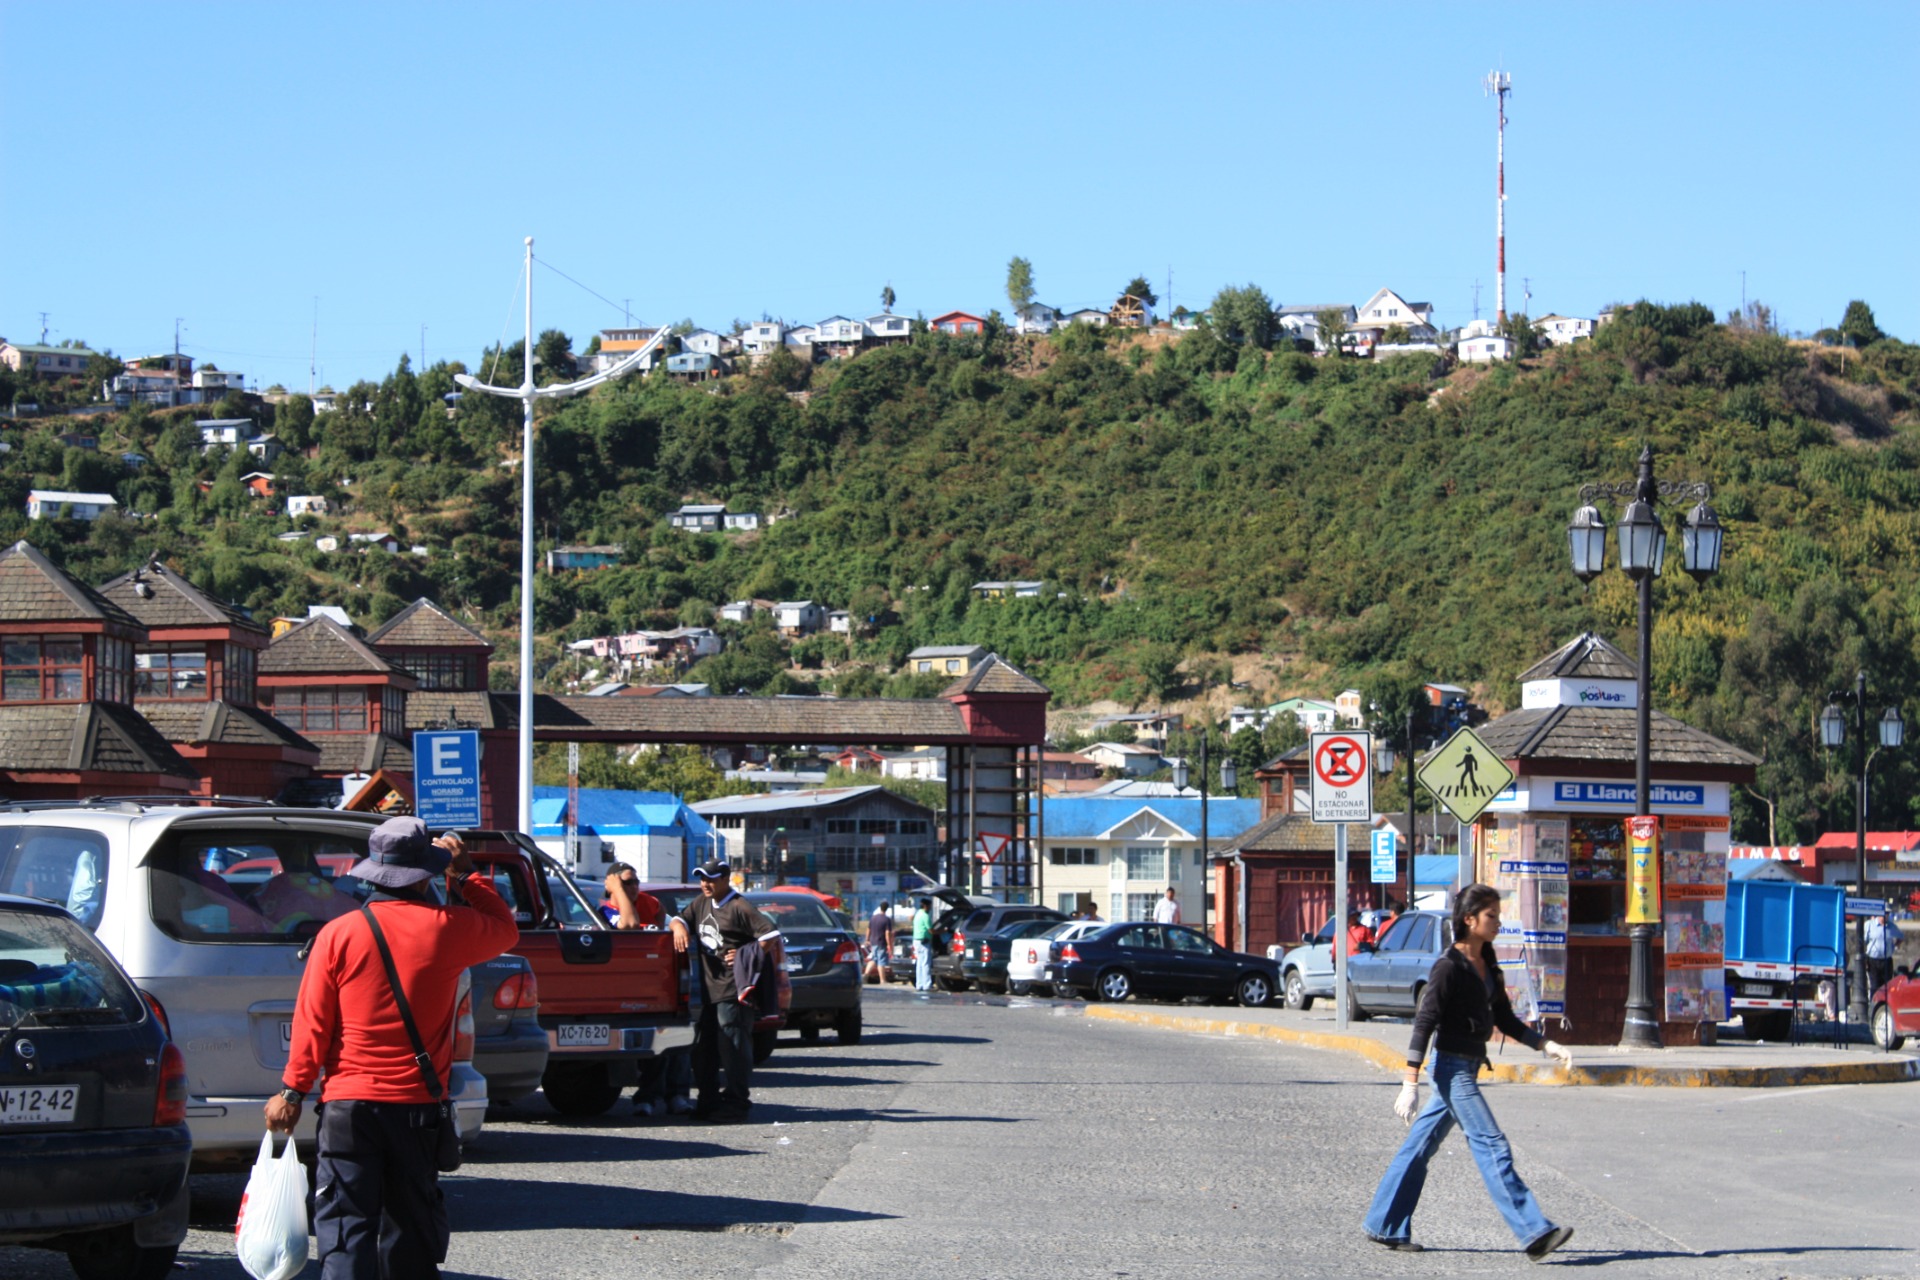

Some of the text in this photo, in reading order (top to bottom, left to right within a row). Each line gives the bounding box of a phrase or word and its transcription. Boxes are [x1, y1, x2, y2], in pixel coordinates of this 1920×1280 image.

[432, 737, 462, 775] E
[422, 778, 474, 786] CONTROLADO
[431, 788, 464, 796] HORARIO
[1335, 790, 1347, 799] NO
[1561, 784, 1580, 799] El
[1318, 800, 1364, 808] ESTACIONAR
[1325, 809, 1367, 817] DETENERSE
[1377, 833, 1390, 855] E
[1502, 863, 1511, 871] El
